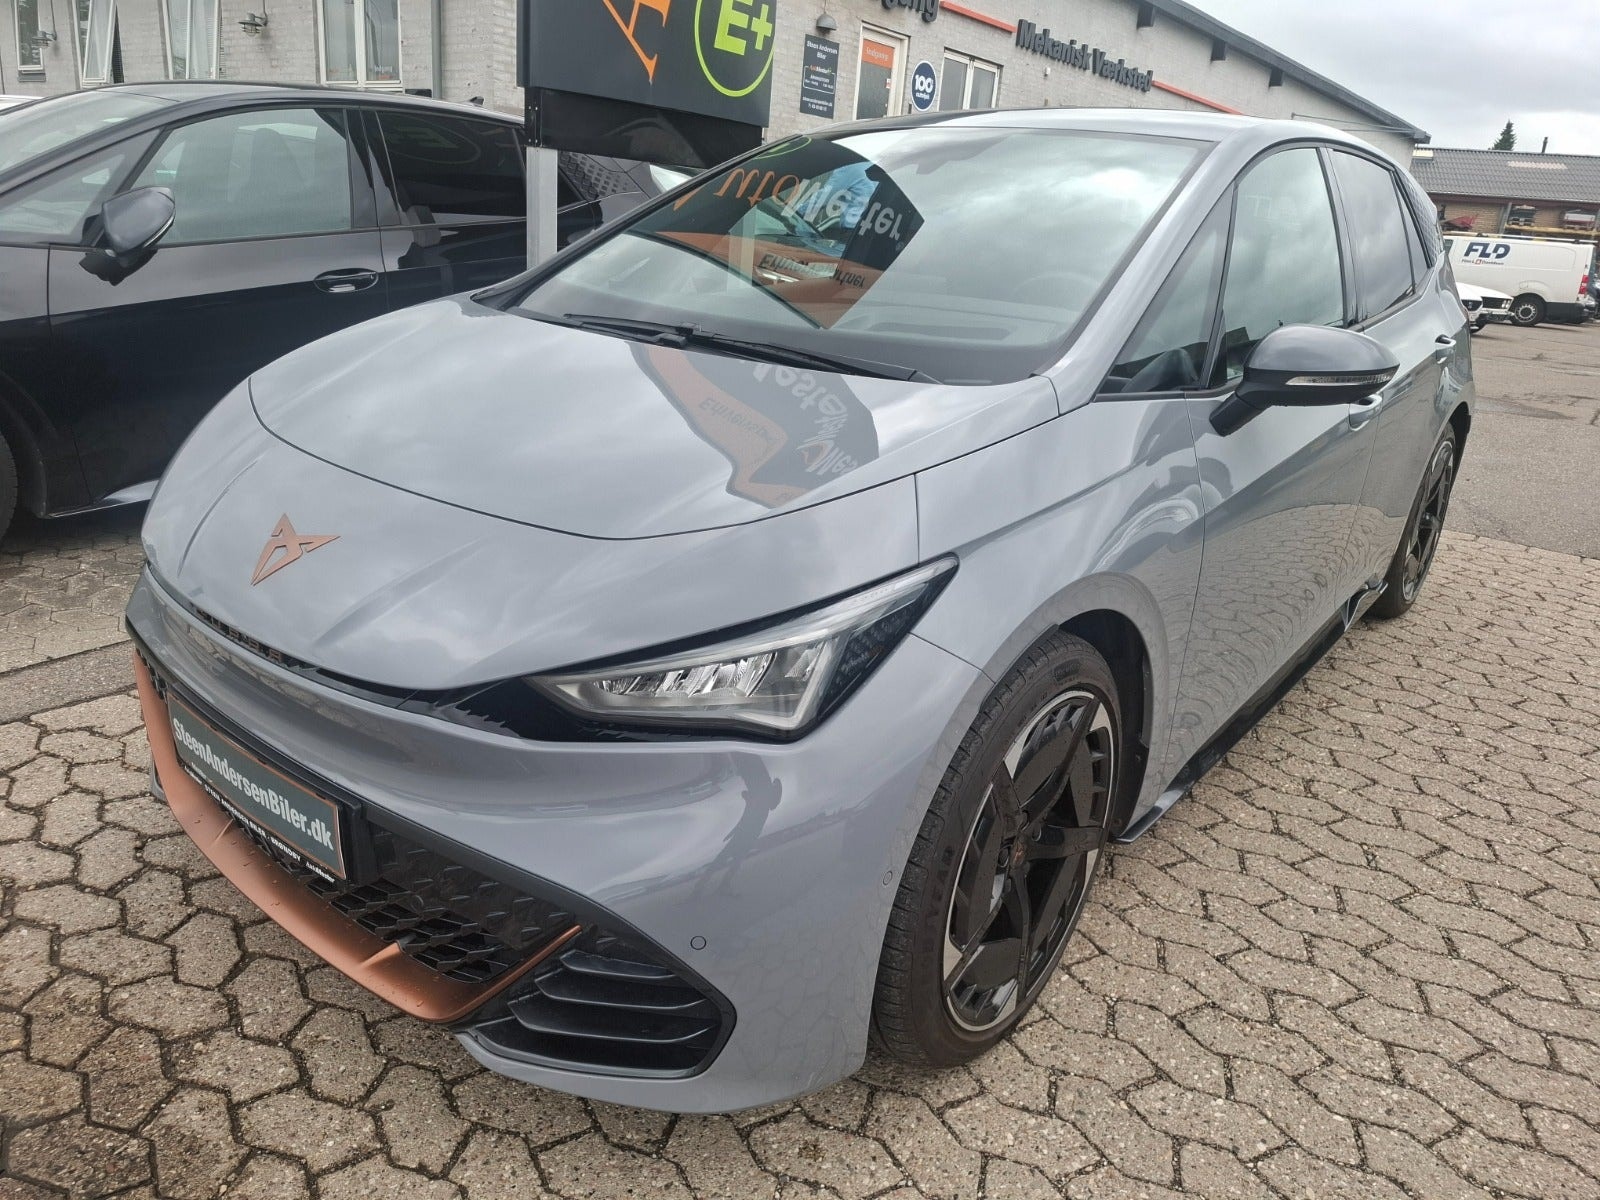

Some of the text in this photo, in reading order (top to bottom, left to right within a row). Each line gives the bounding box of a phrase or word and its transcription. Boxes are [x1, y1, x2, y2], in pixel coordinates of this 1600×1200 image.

[1015, 19, 1153, 92] Mekanisk Værksted
[1464, 242, 1511, 259] FLD
[173, 717, 334, 851] SteenAndersenBiler.dk
